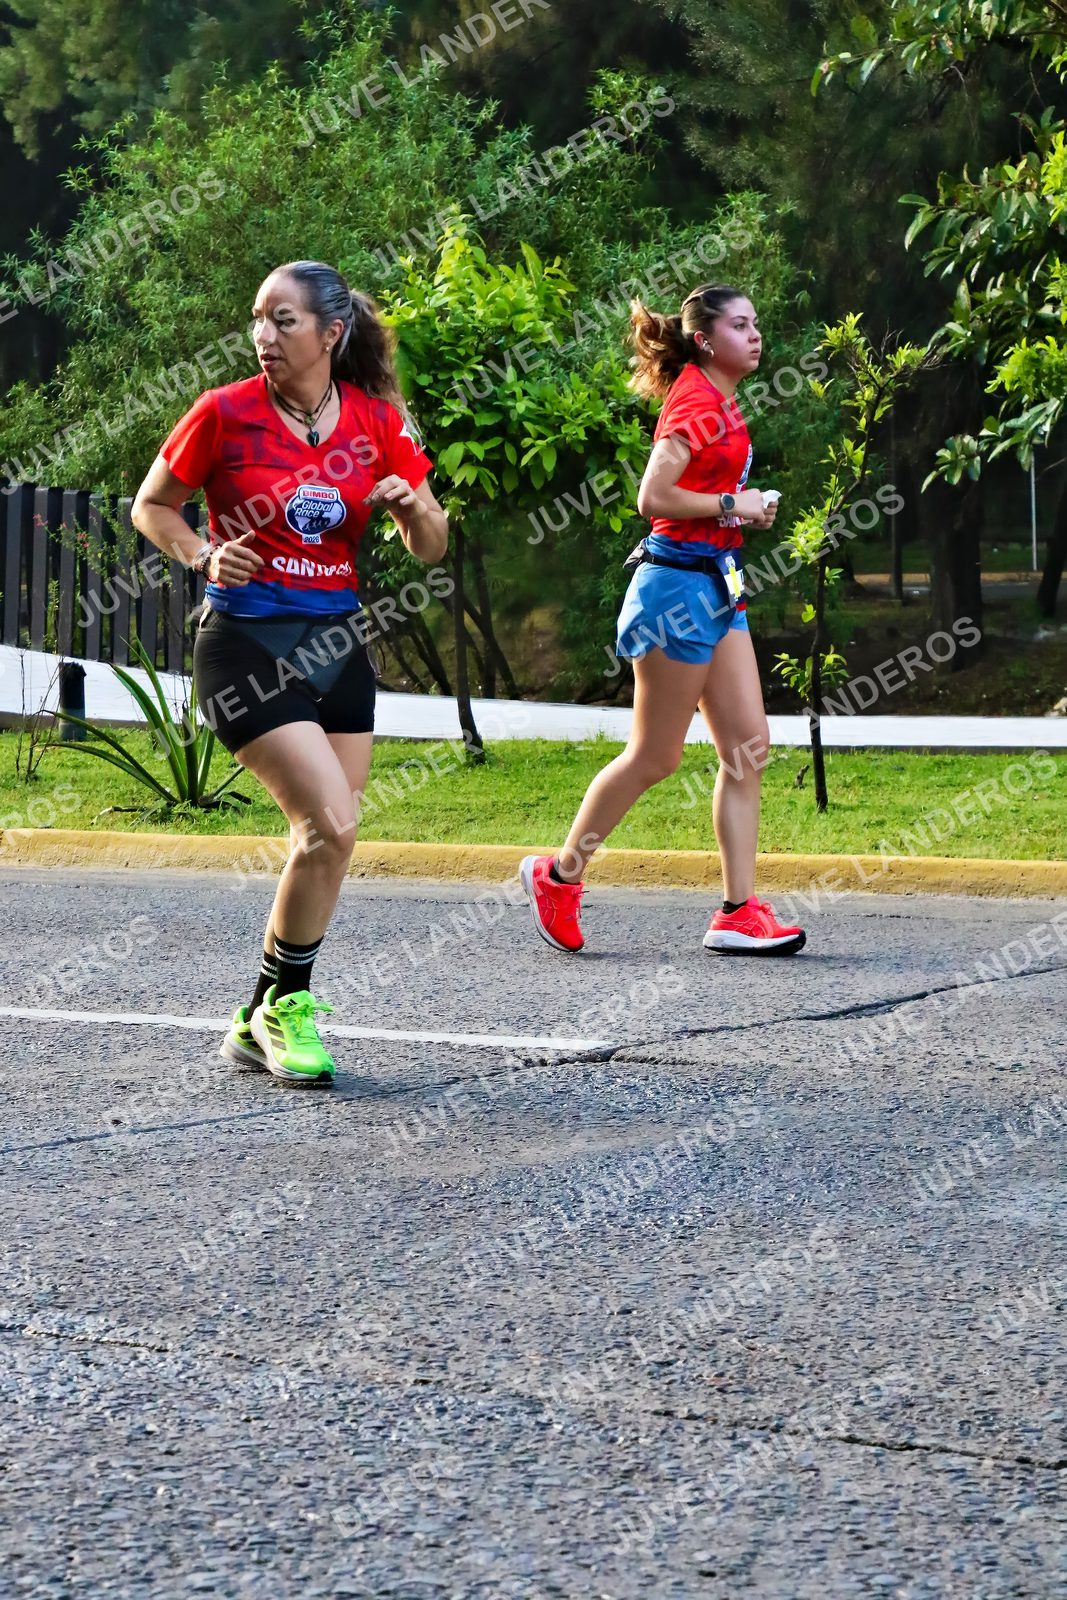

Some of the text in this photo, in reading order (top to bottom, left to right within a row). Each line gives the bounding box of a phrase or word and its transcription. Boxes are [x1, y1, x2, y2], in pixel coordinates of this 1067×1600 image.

[302, 490, 335, 499] BIMBO
[301, 500, 334, 512] Global
[294, 508, 320, 518] Race
[303, 535, 320, 543] 2026
